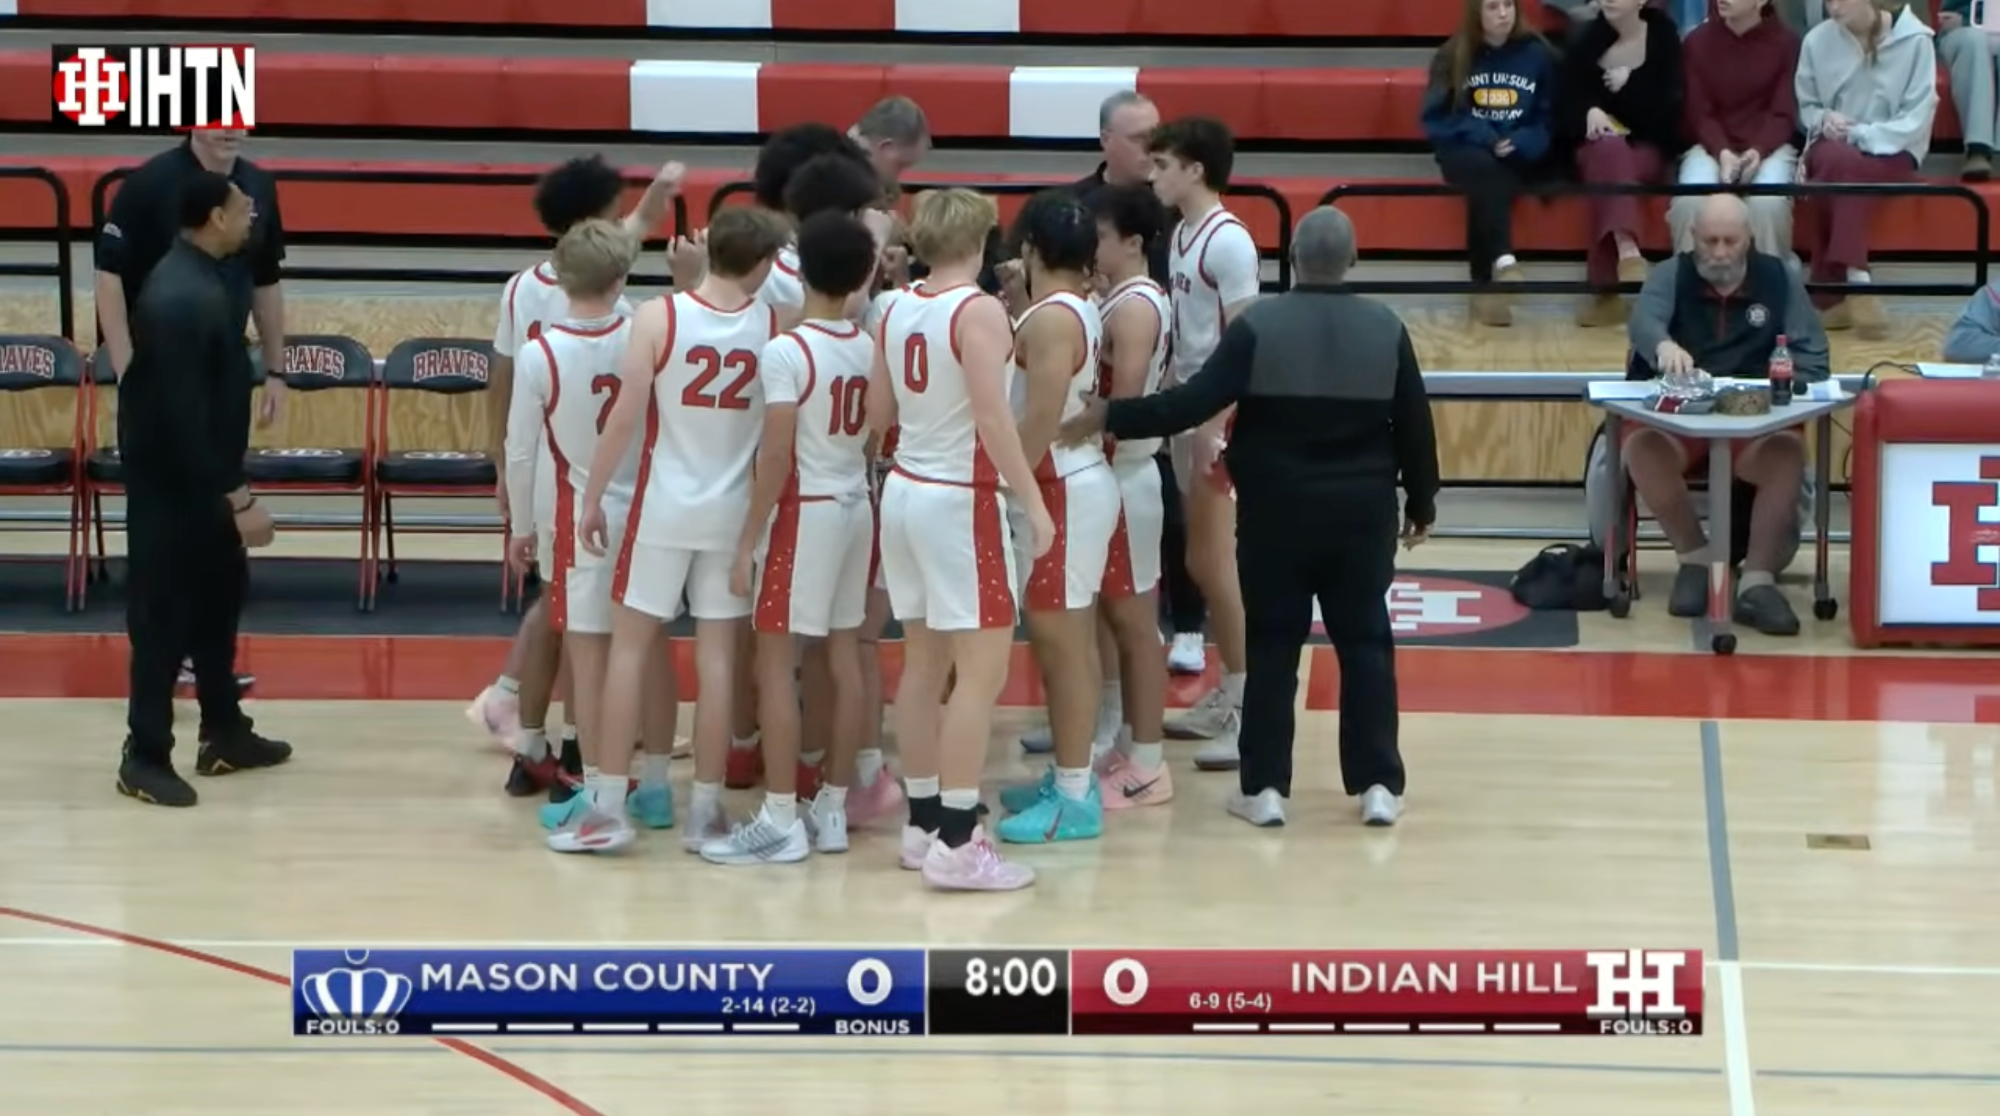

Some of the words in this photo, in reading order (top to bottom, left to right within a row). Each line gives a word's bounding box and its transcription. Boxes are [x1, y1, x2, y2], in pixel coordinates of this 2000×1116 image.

[0, 345, 55, 379] AVES
[284, 346, 344, 379] RAVES
[413, 348, 488, 382] BRAVES
[681, 345, 758, 410] 22
[904, 332, 929, 393] 0
[828, 375, 868, 436] 10
